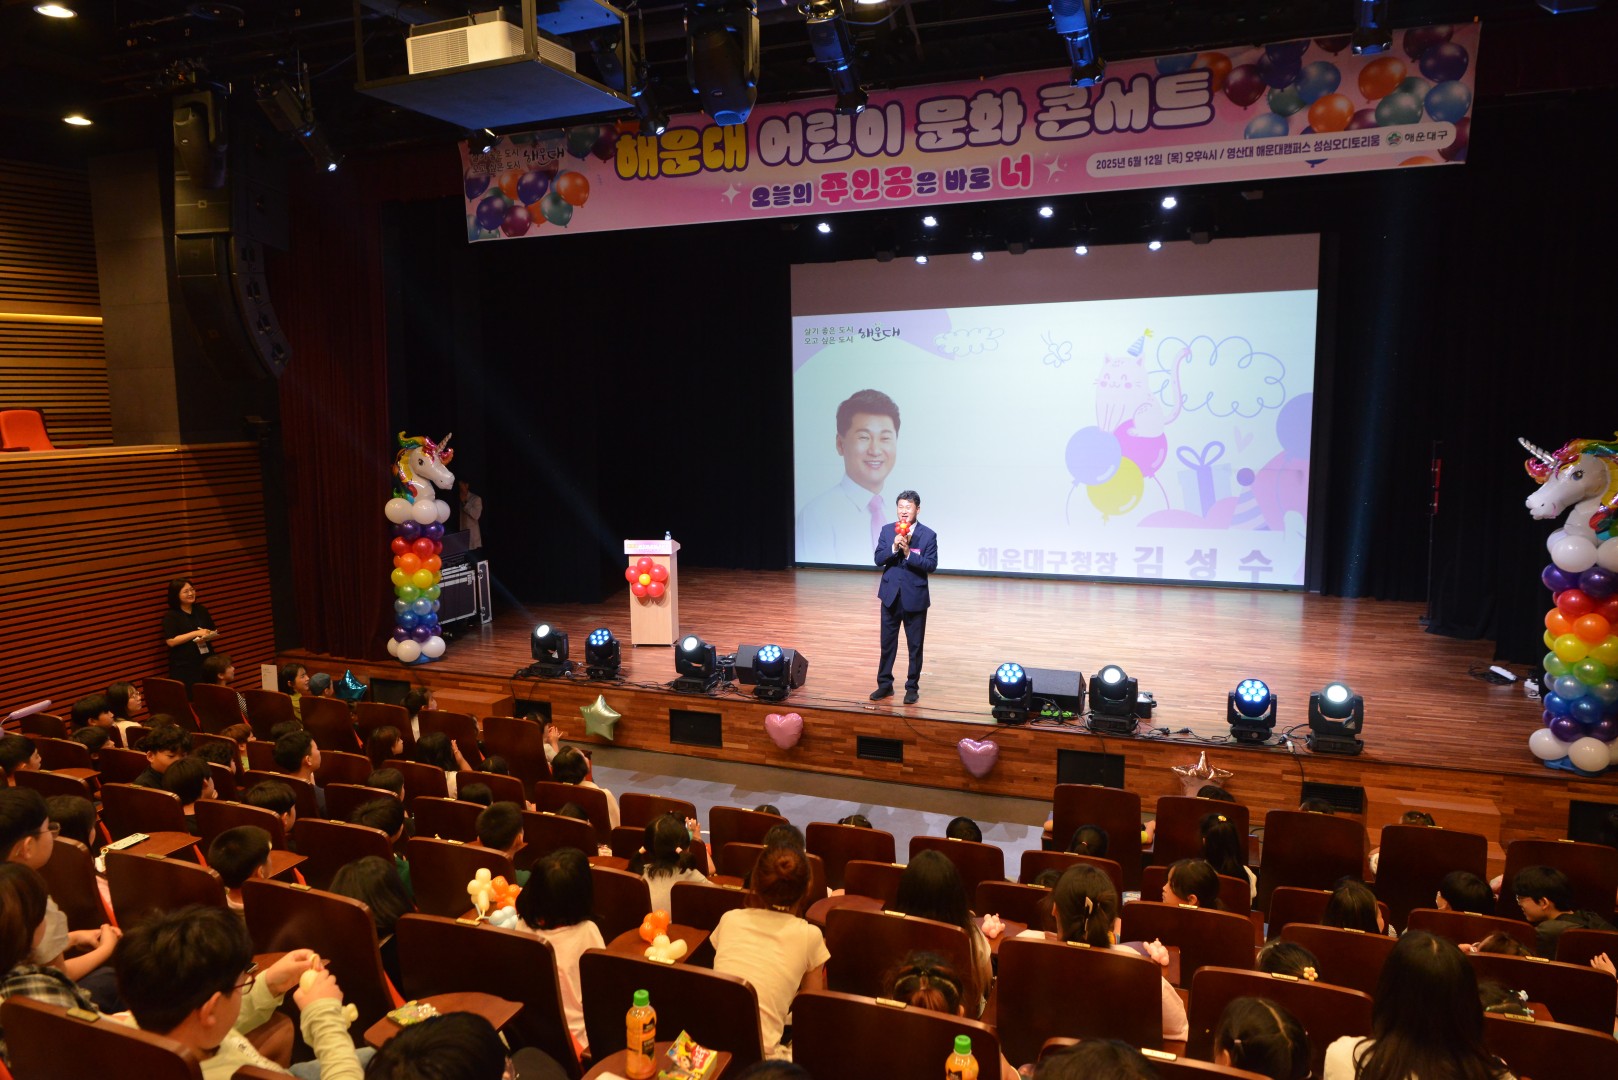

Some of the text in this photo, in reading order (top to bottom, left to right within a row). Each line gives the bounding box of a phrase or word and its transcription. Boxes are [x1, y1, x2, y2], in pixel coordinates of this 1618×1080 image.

[614, 67, 1215, 182] 해운대 어린이 문화 콘서트
[1404, 130, 1449, 143] 해운대구
[504, 148, 519, 158] 도시
[523, 146, 565, 165] 해운대
[1096, 157, 1126, 170] 2025년
[1127, 155, 1142, 168] 6월
[1144, 154, 1163, 166] 12일
[1185, 149, 1218, 163] 오후4시
[1226, 145, 1254, 159] 영산대
[1256, 141, 1311, 157] 해운대캠퍼스
[1313, 134, 1381, 153] 성심오디토리움
[506, 160, 521, 170] 도시
[751, 152, 1034, 208] 오늘의 주인공은 바로 너
[804, 325, 854, 336] 살기 좋은 도시
[804, 335, 854, 345] 오고 싶은 도시
[858, 323, 900, 342] 해운대
[977, 545, 1274, 583] 해운대구청장 김 성 수
